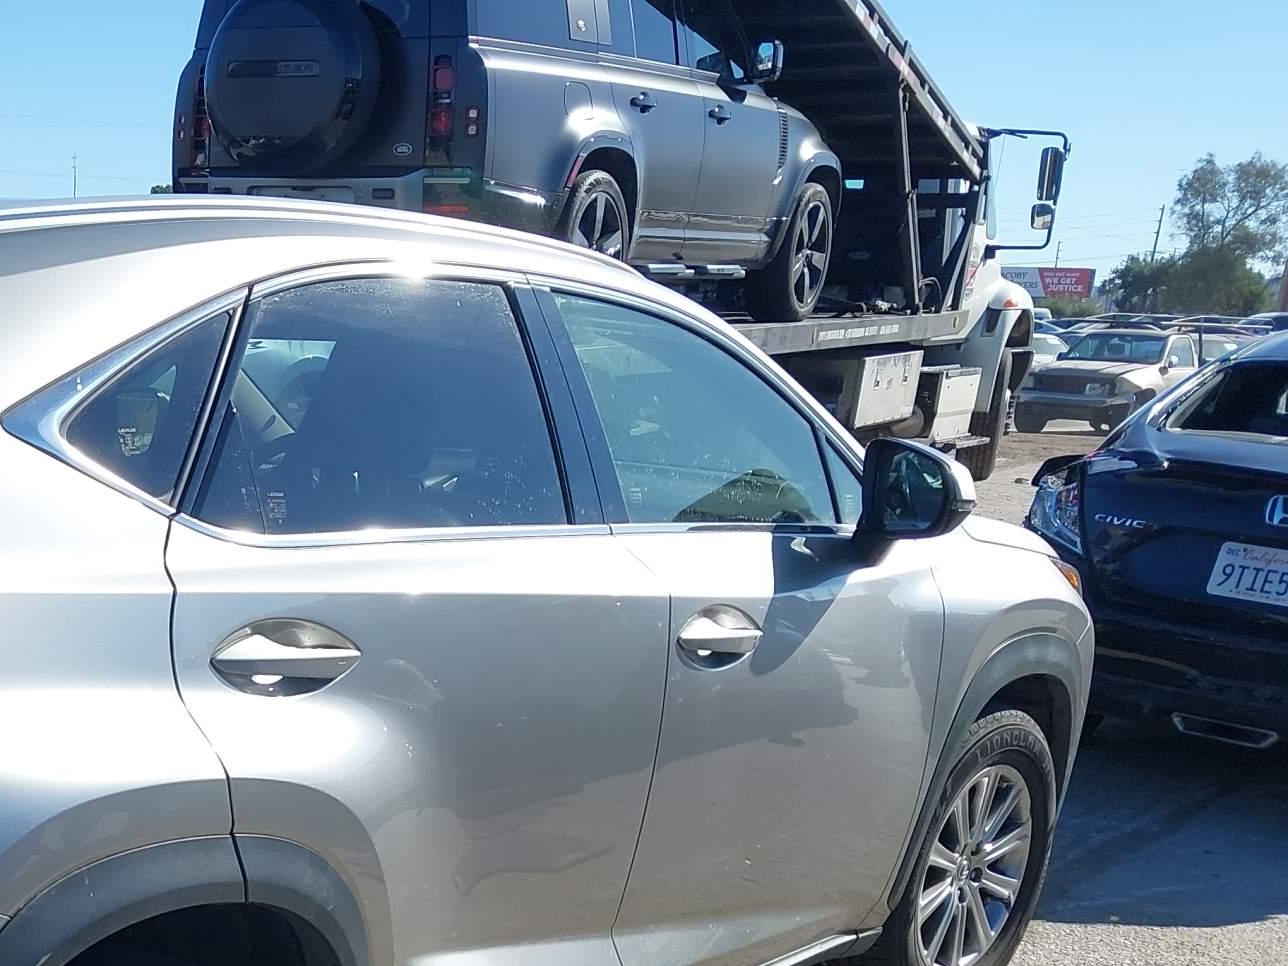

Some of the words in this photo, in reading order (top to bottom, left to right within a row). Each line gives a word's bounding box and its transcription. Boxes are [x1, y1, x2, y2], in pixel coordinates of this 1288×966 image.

[1047, 284, 1084, 292] JUSTICE
[1094, 513, 1146, 529] CIVIC
[1216, 563, 1288, 596] 9TIE5
